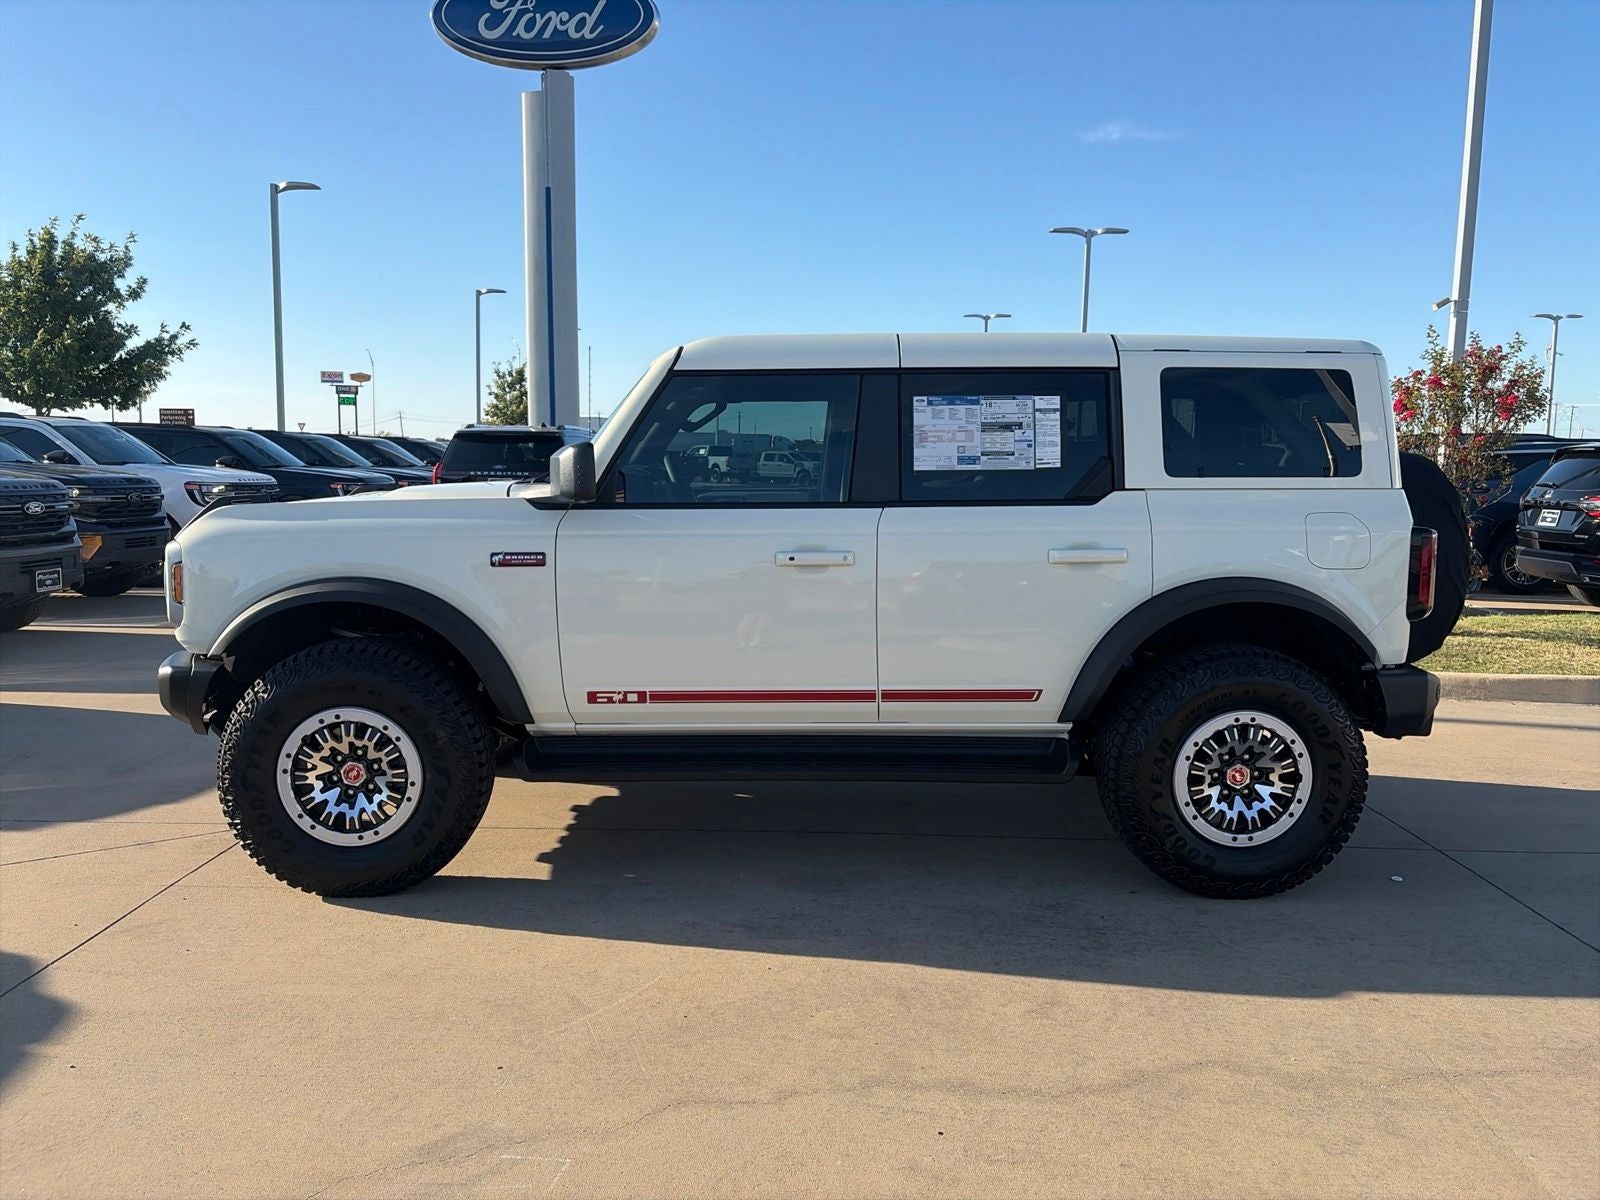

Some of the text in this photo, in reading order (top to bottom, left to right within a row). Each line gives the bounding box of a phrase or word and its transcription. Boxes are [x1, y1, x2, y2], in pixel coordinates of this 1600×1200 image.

[478, 0, 604, 39] Ford
[1149, 738, 1217, 865] GOODYEAR
[1278, 692, 1342, 824] GOODYEAR
